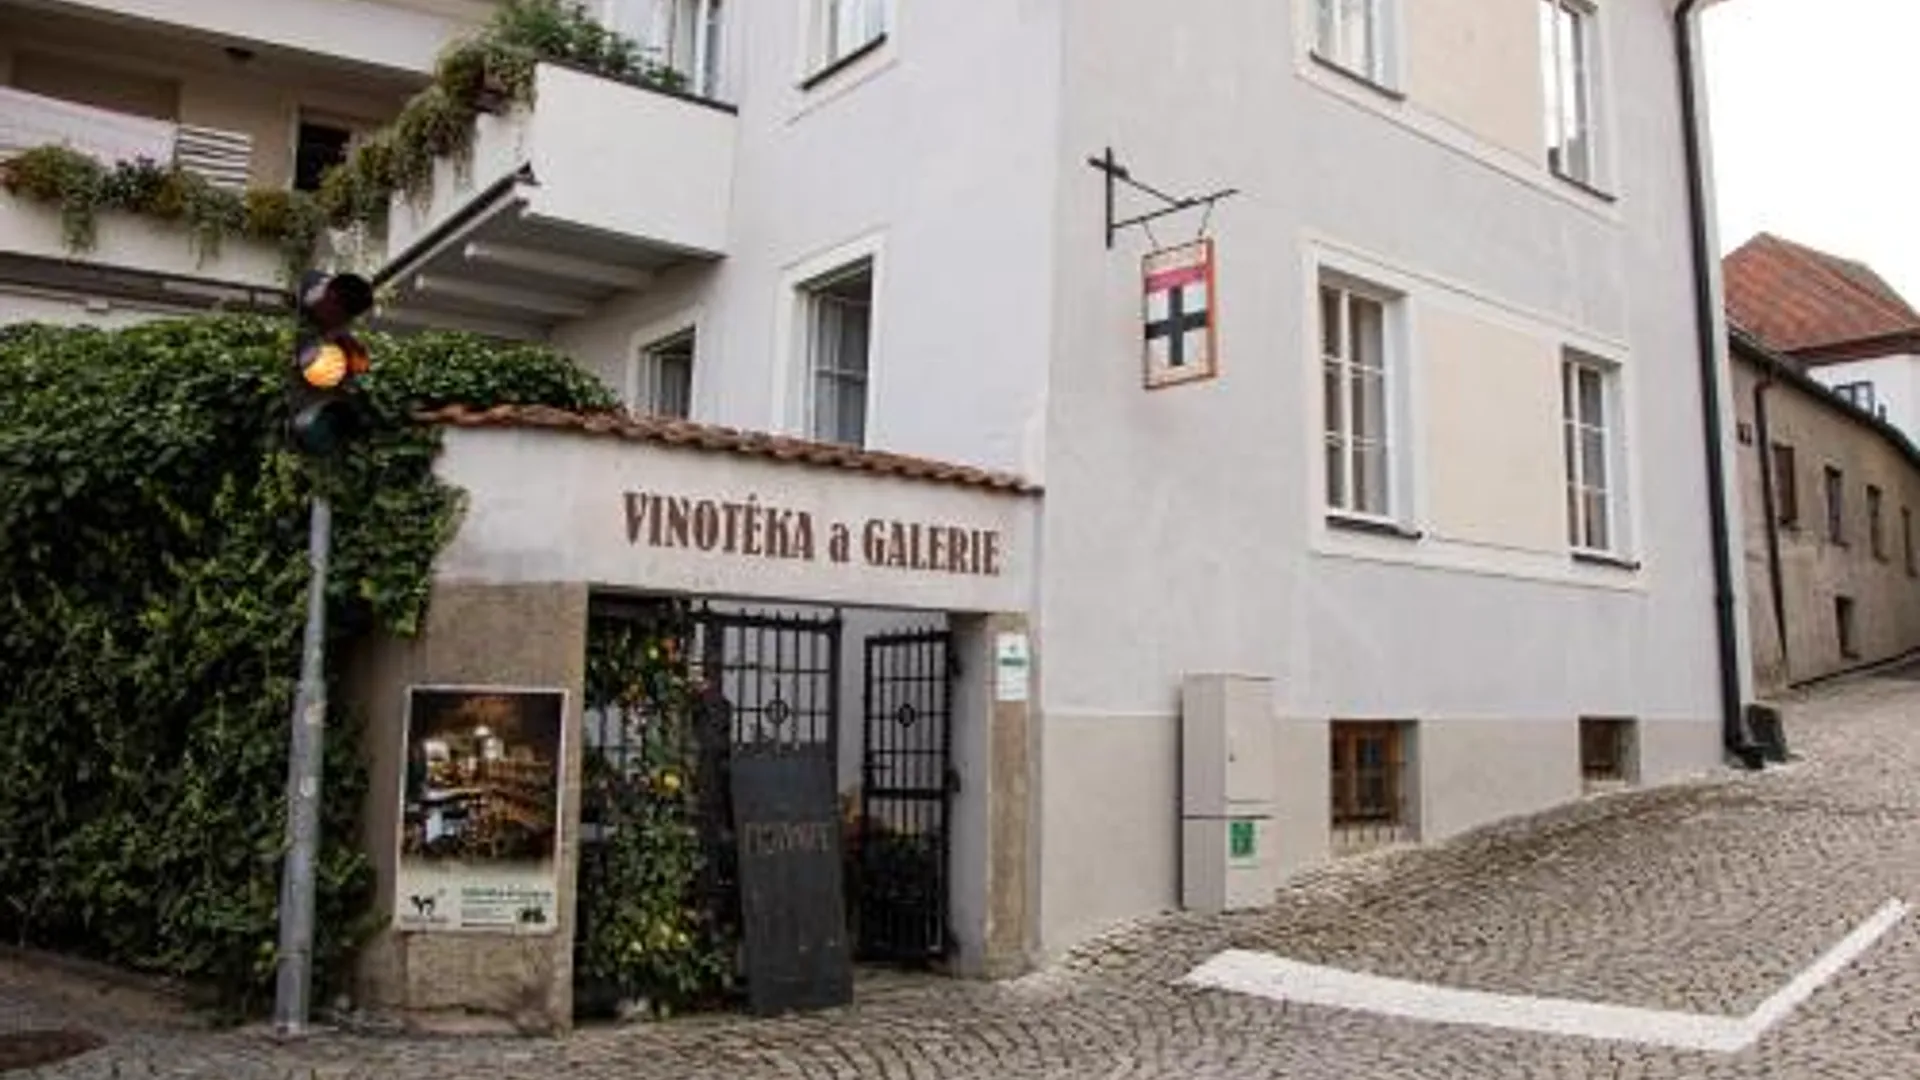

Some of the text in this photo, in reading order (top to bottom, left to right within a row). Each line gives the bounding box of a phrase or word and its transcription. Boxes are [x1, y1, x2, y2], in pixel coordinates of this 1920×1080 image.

[623, 491, 1001, 577] VINOTÉKA a GALERIE
